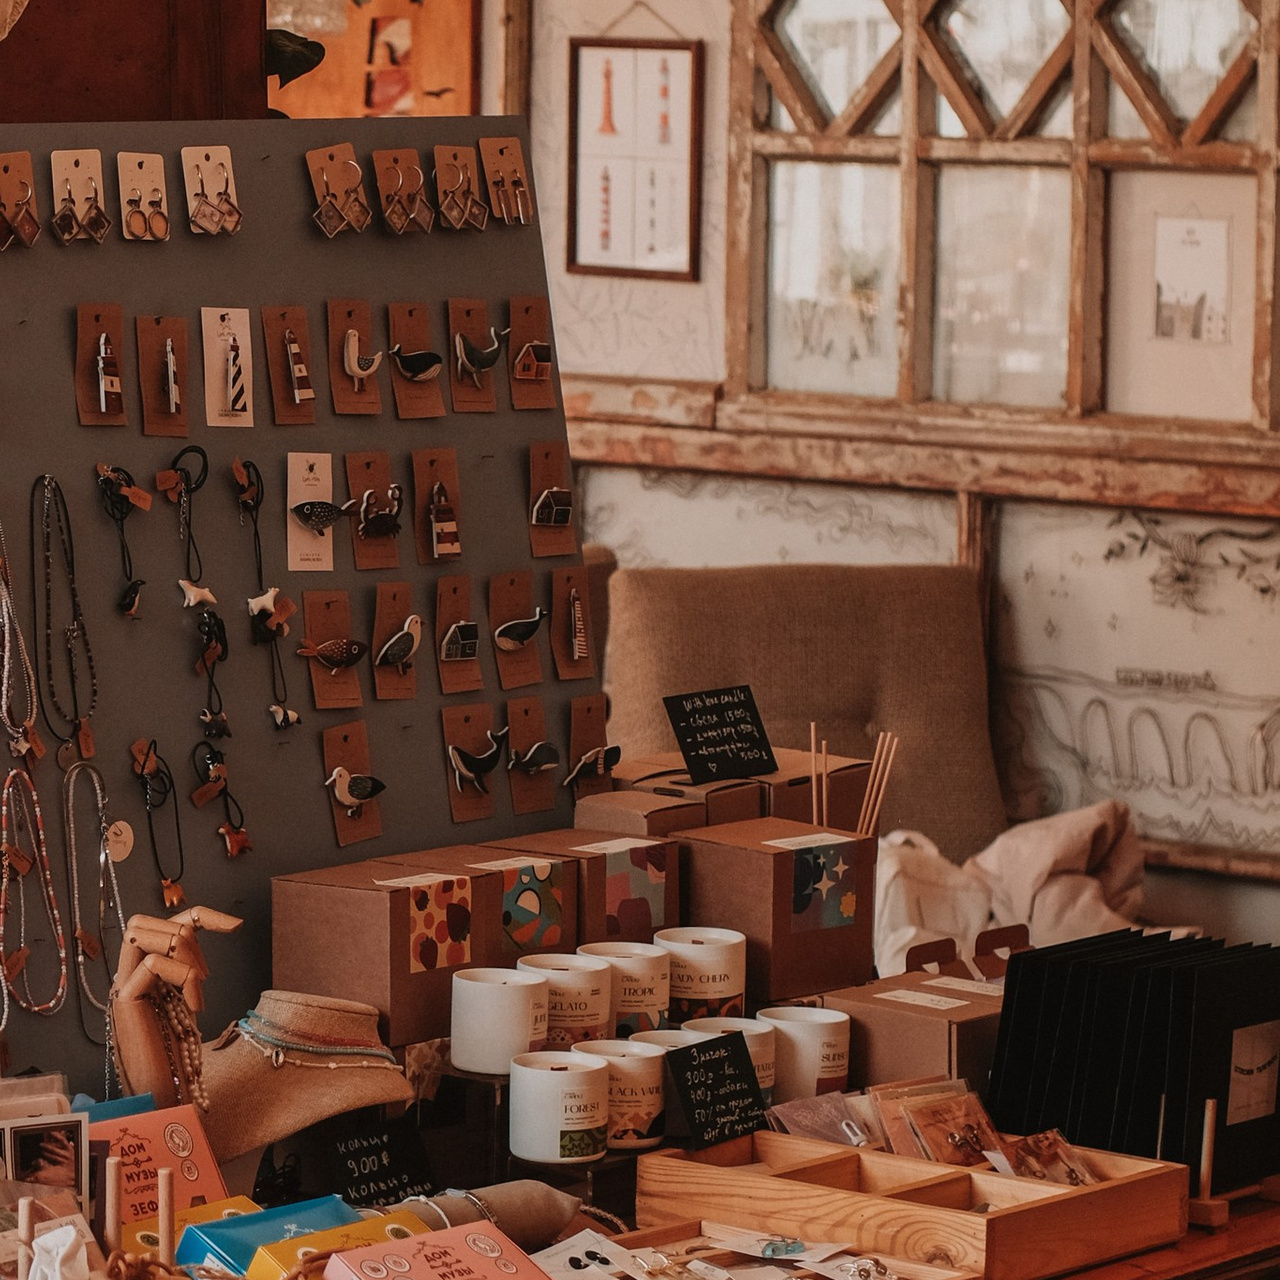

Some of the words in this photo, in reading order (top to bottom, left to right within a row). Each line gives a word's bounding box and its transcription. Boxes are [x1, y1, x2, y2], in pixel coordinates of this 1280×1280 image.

[120, 1142, 146, 1158] ДОМ
[424, 1249, 452, 1263] ДОМ
[438, 1267, 475, 1280] МУЗЫ
